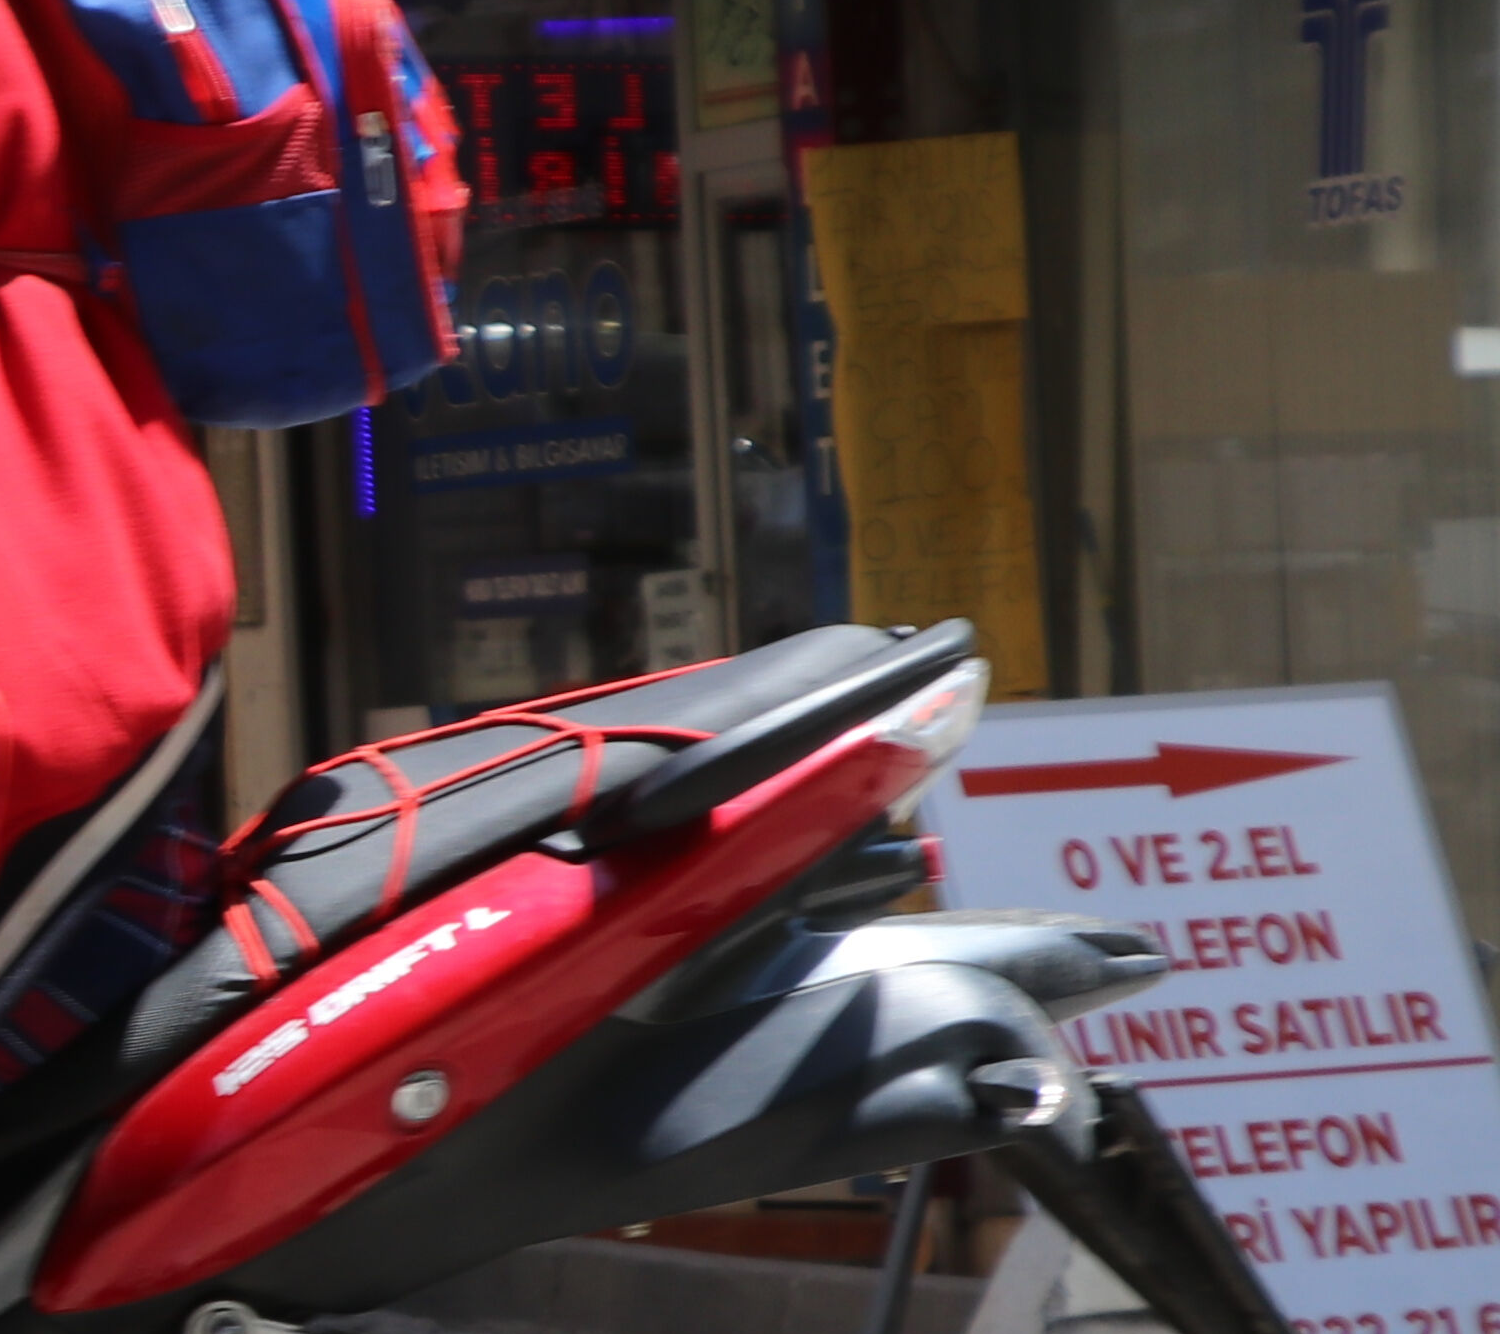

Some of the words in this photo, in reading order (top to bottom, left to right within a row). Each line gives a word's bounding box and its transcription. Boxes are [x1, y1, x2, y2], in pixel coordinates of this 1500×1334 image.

[1108, 832, 1193, 886] VE
[1197, 824, 1323, 882] 2.EL
[1233, 990, 1449, 1057] SATILIR
[1289, 1192, 1500, 1259] YAPILIR
